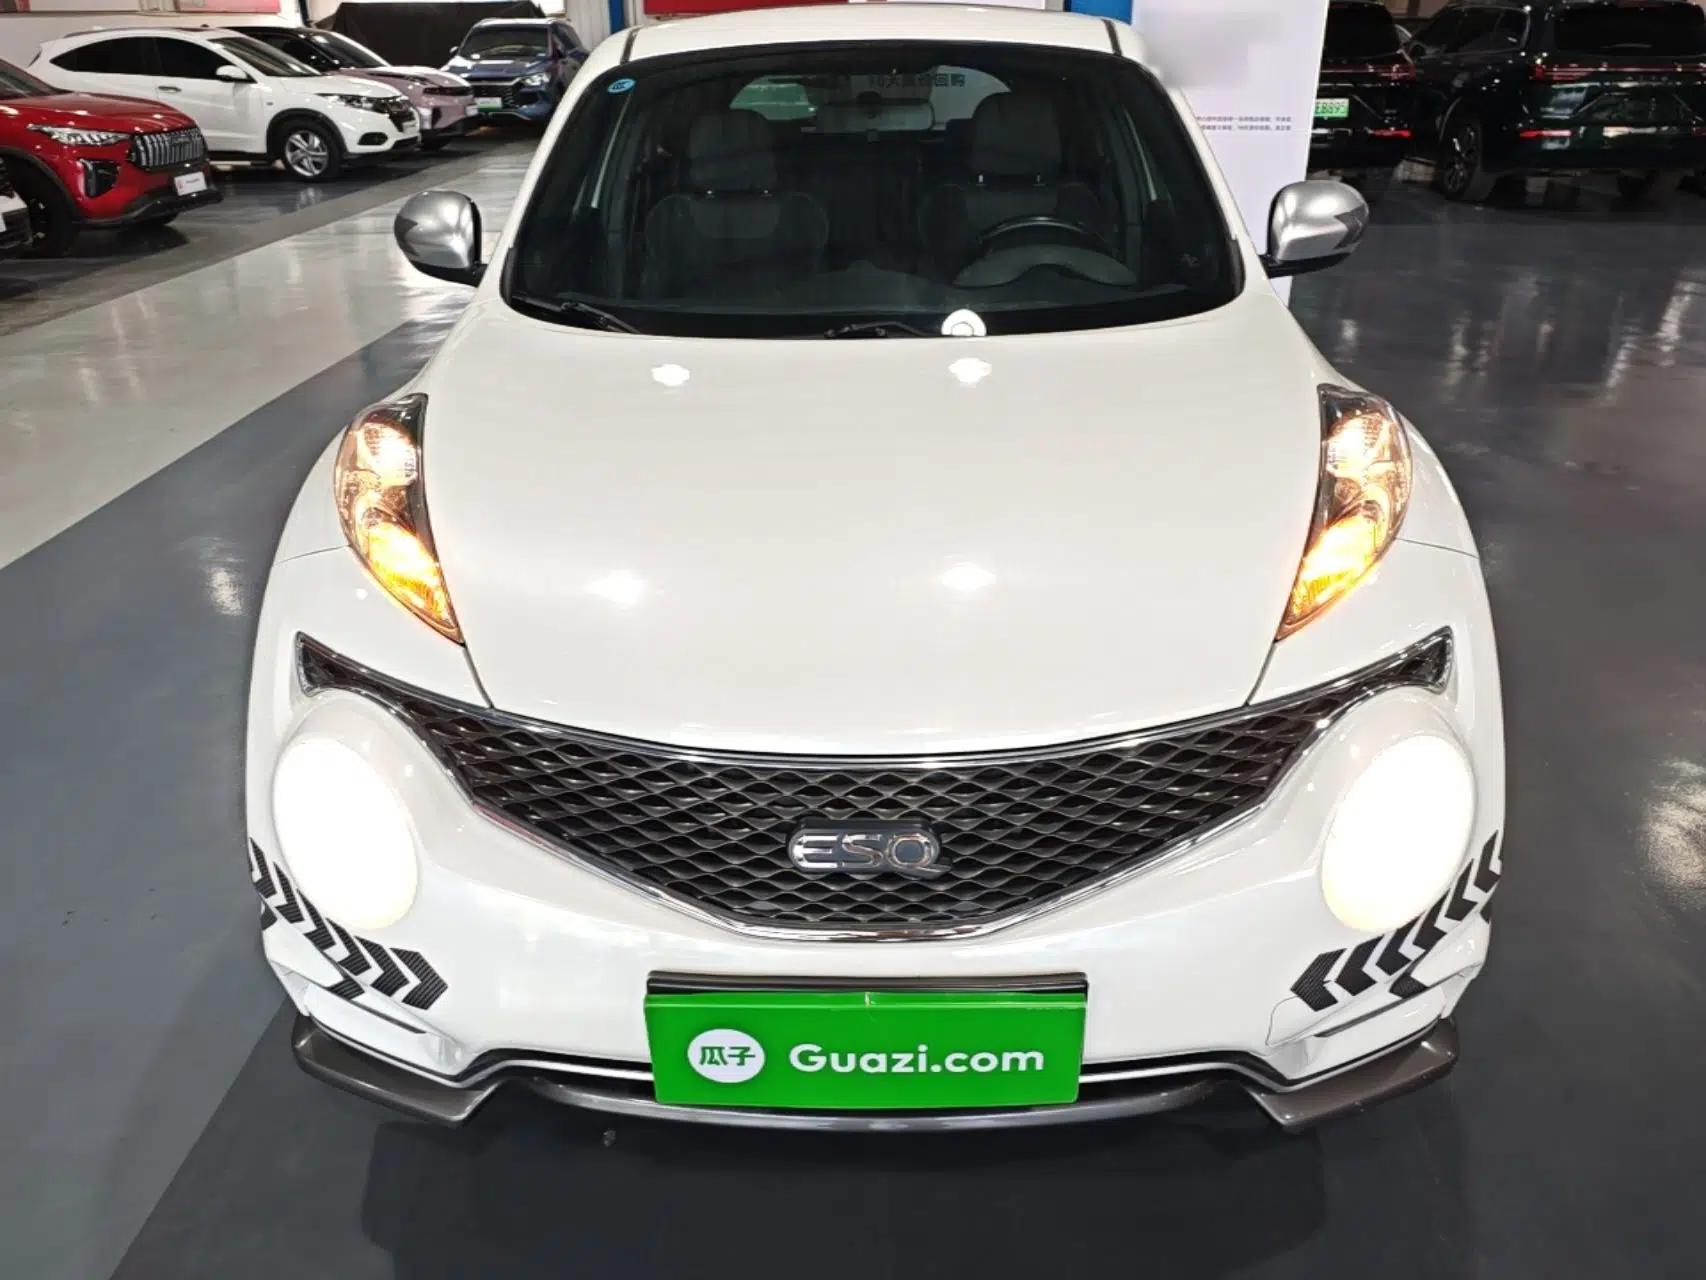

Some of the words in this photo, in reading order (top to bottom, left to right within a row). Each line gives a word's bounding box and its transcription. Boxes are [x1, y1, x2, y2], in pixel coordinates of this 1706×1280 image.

[791, 832, 946, 879] ESQ
[699, 1045, 755, 1068] 瓜子
[789, 1043, 1045, 1074] Guazi.com
